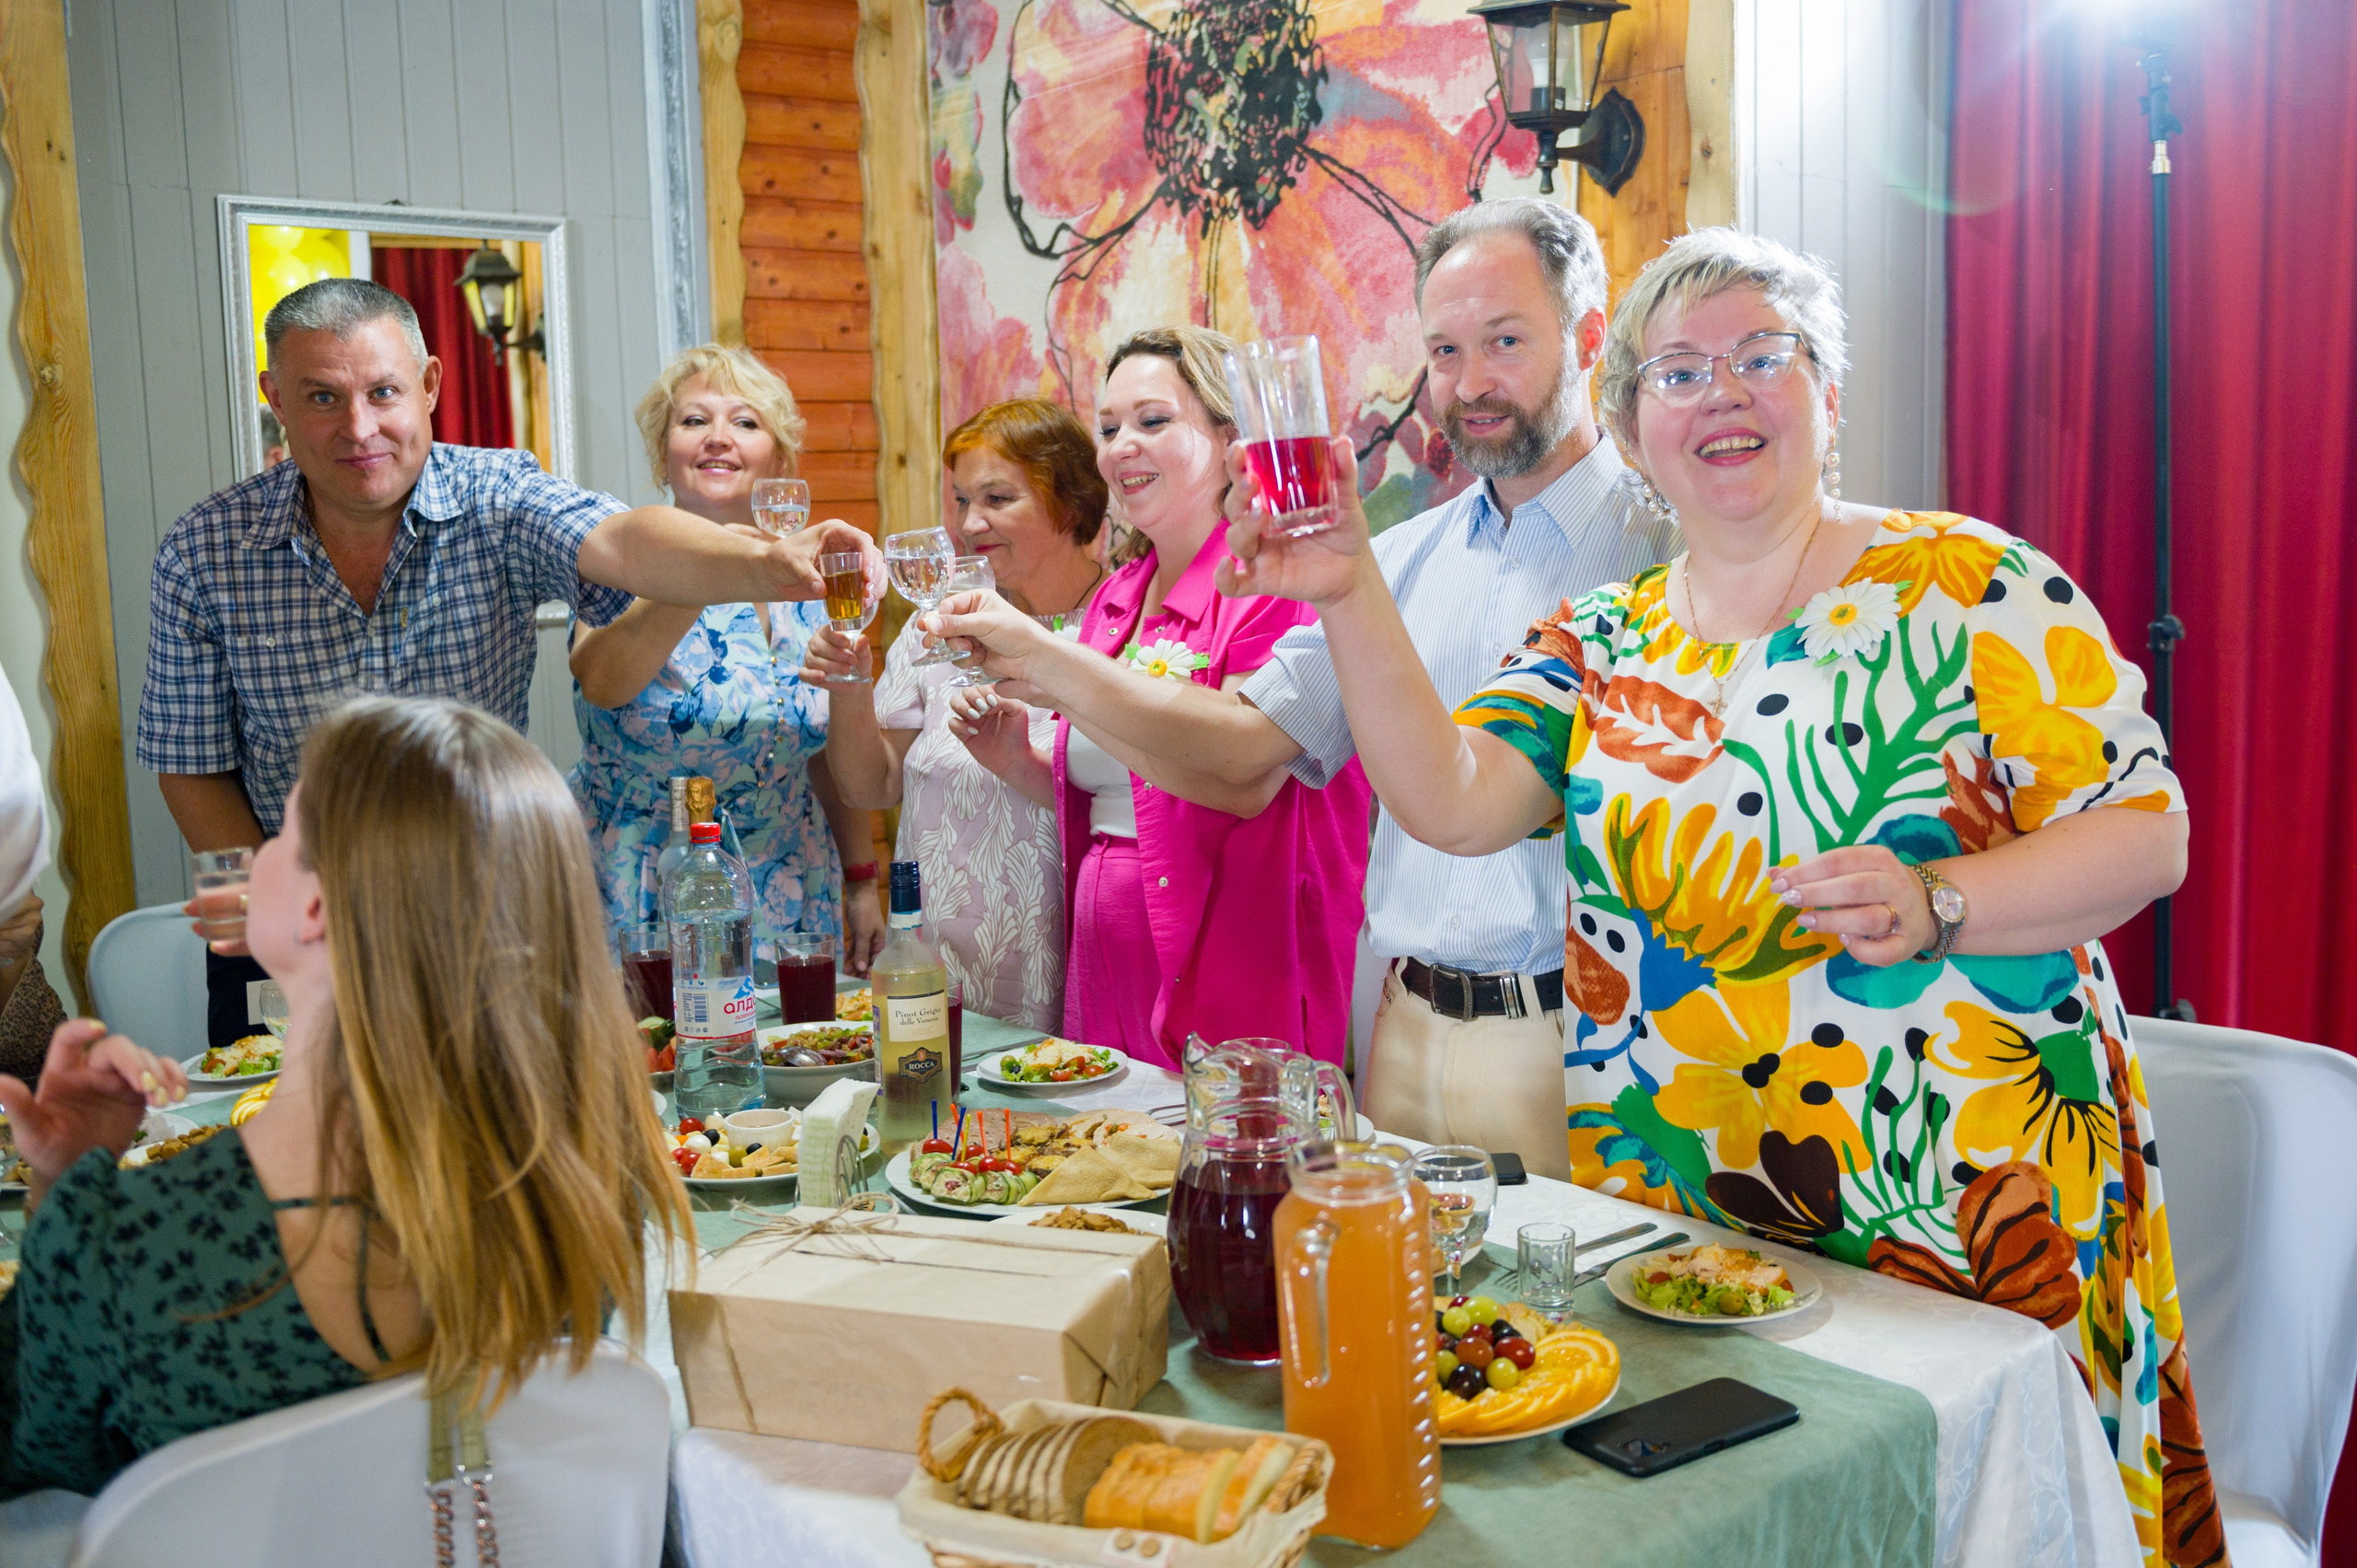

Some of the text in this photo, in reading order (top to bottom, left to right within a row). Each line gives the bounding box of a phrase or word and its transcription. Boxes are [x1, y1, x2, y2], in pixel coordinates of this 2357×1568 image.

[895, 1007, 942, 1018] Pinot Grigio
[900, 1016, 939, 1026] delle Venezie
[909, 1061, 935, 1070] ROCCA
